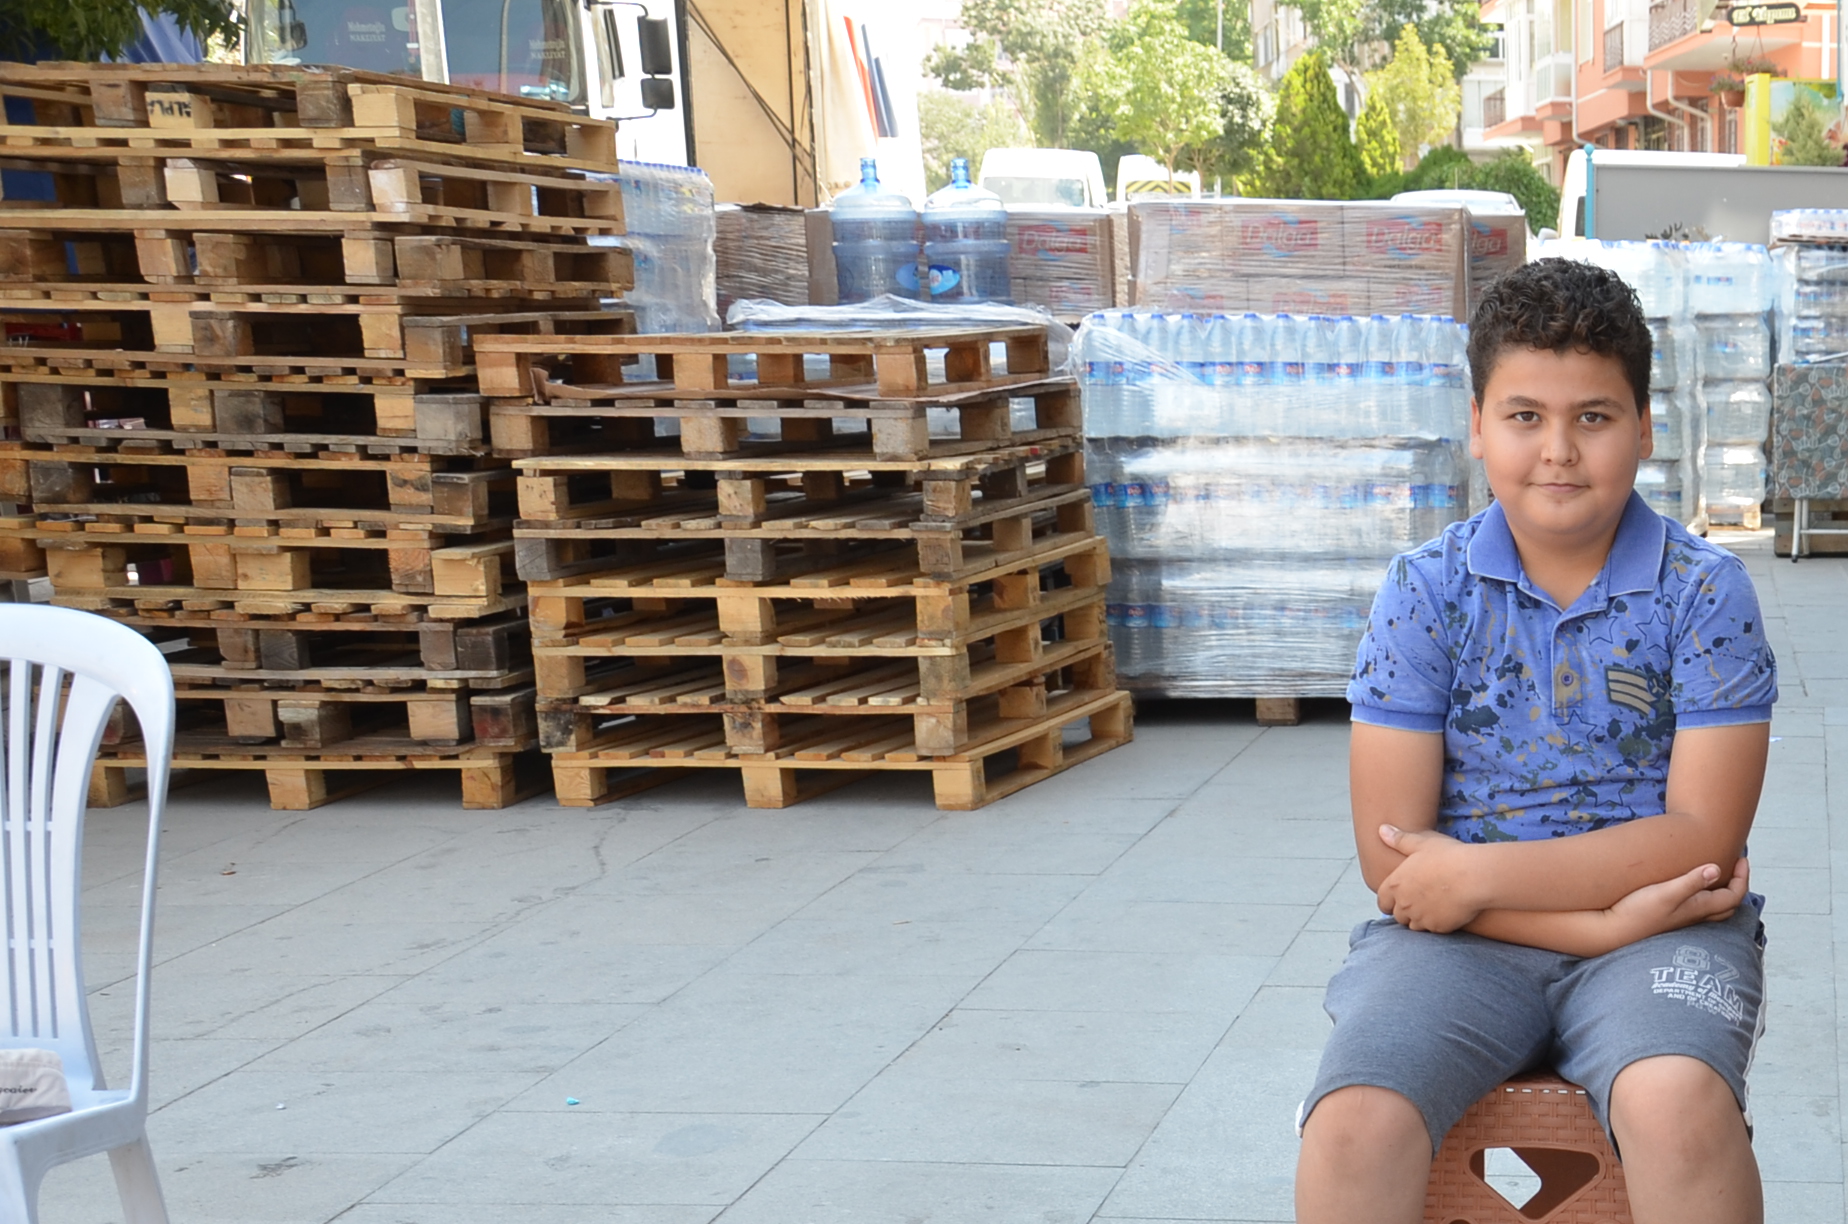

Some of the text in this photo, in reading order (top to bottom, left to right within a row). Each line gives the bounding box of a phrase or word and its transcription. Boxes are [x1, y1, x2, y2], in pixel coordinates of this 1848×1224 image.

[1023, 231, 1083, 255] Dalga
[1248, 223, 1313, 250] Dalga
[1371, 226, 1438, 251] Dalga
[1673, 945, 1740, 982] 87
[1650, 967, 1744, 1020] TEAM
